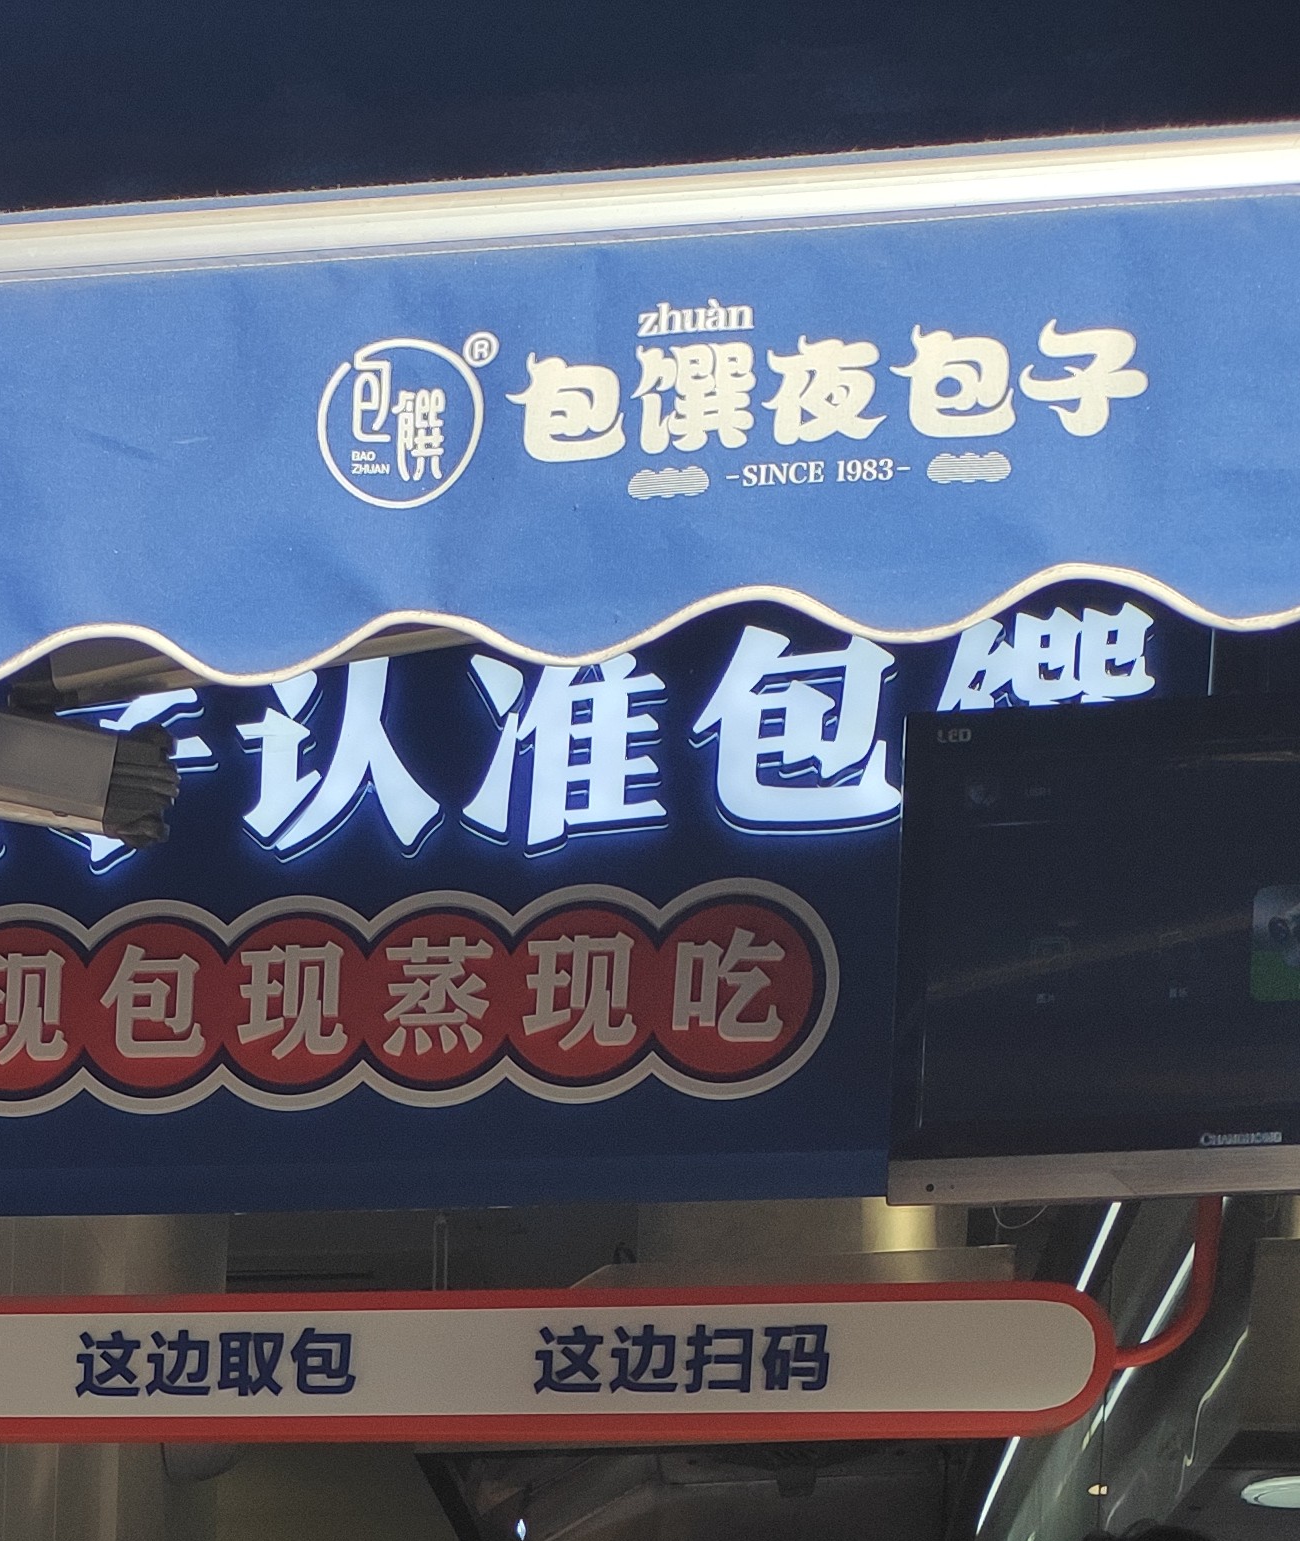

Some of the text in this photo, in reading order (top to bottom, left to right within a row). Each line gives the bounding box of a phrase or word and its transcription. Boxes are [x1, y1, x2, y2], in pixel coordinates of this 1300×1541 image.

[637, 299, 754, 337] zhuàn
[506, 319, 1149, 462] 包馔夜包子
[351, 451, 377, 462] BAO
[351, 463, 391, 475] ZHUAN
[937, 728, 972, 744] LED
[73, 1329, 358, 1400] 这边取包
[533, 1322, 832, 1398] 这边扫码
